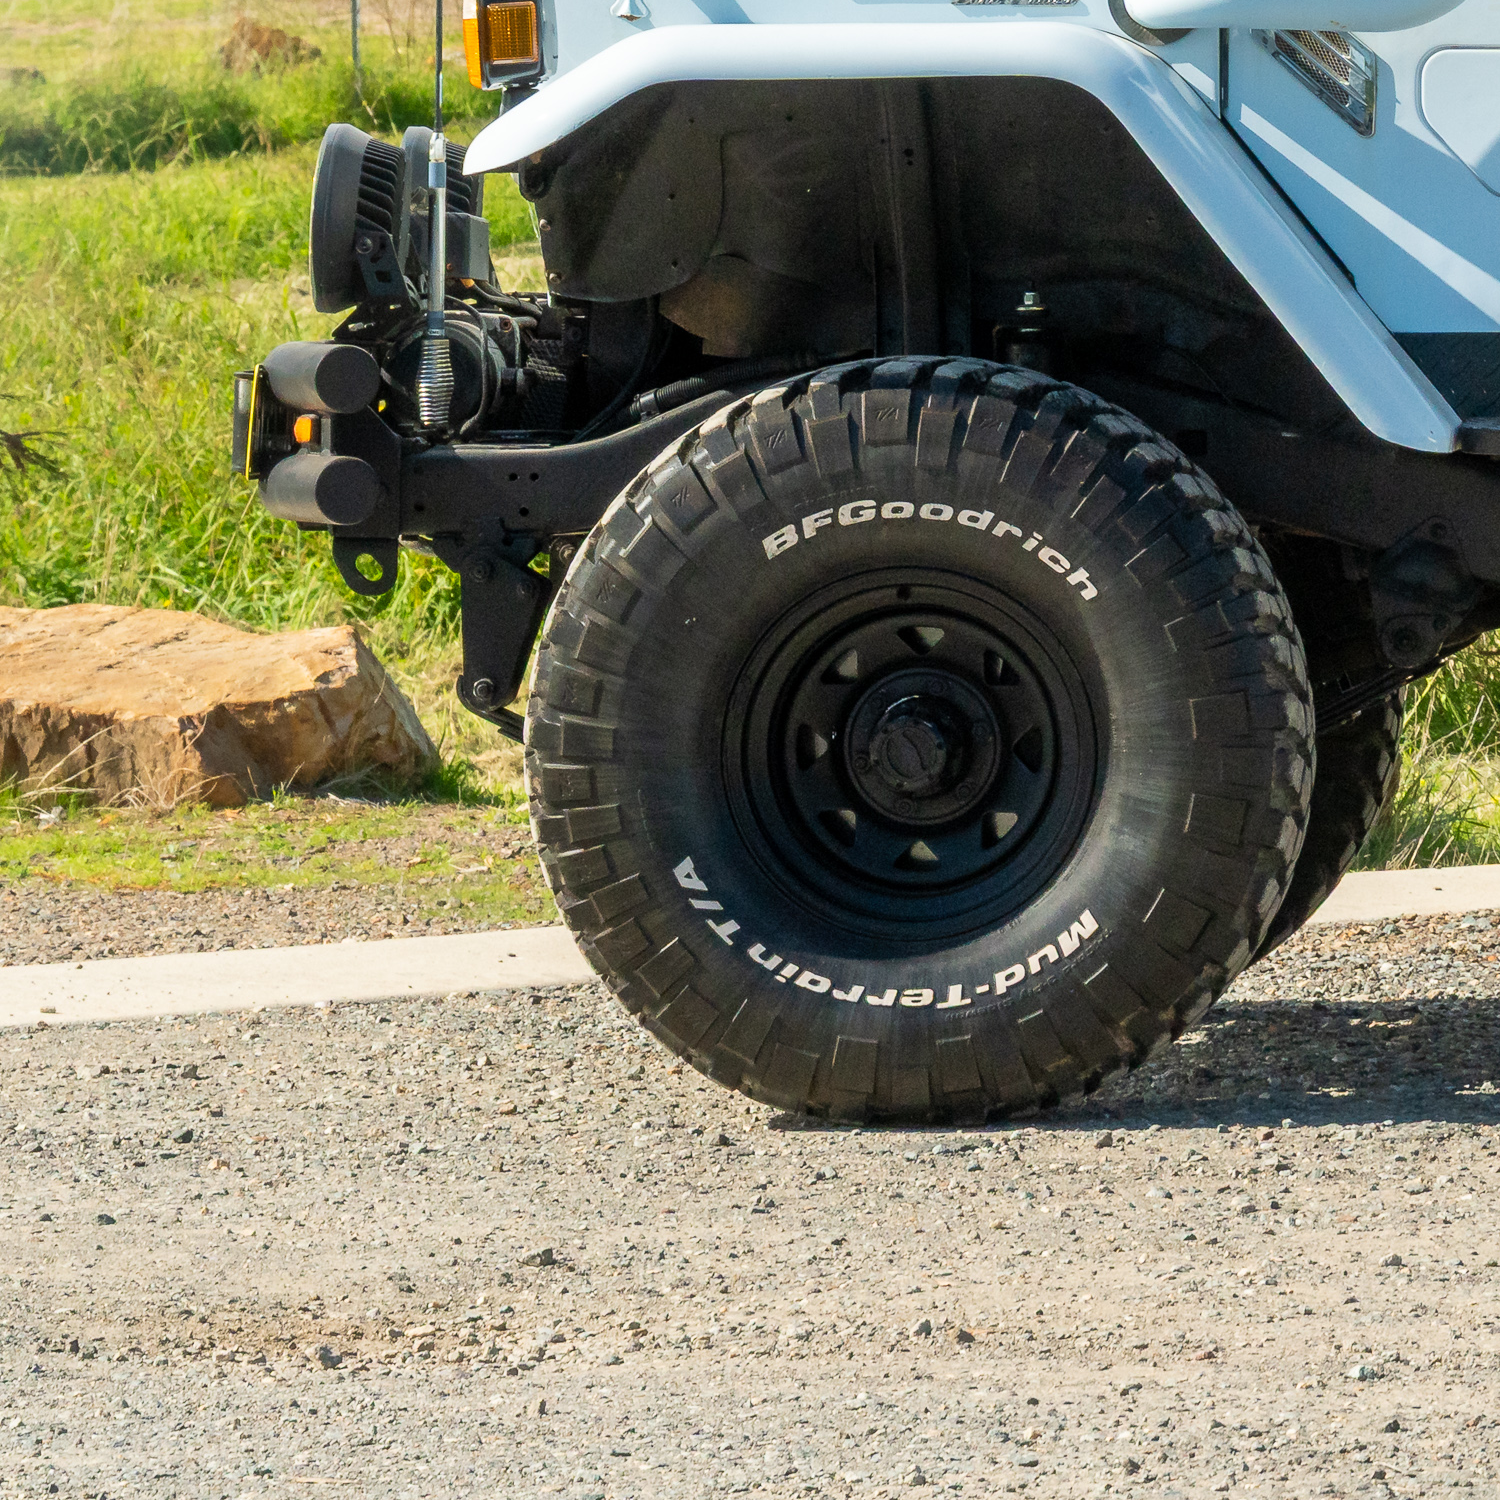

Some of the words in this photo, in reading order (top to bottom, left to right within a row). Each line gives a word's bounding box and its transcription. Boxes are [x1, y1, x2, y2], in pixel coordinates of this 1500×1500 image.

[762, 499, 1099, 601] BFGoodrich
[672, 855, 742, 947] T/A
[746, 908, 1100, 1010] Mud-Terrain
